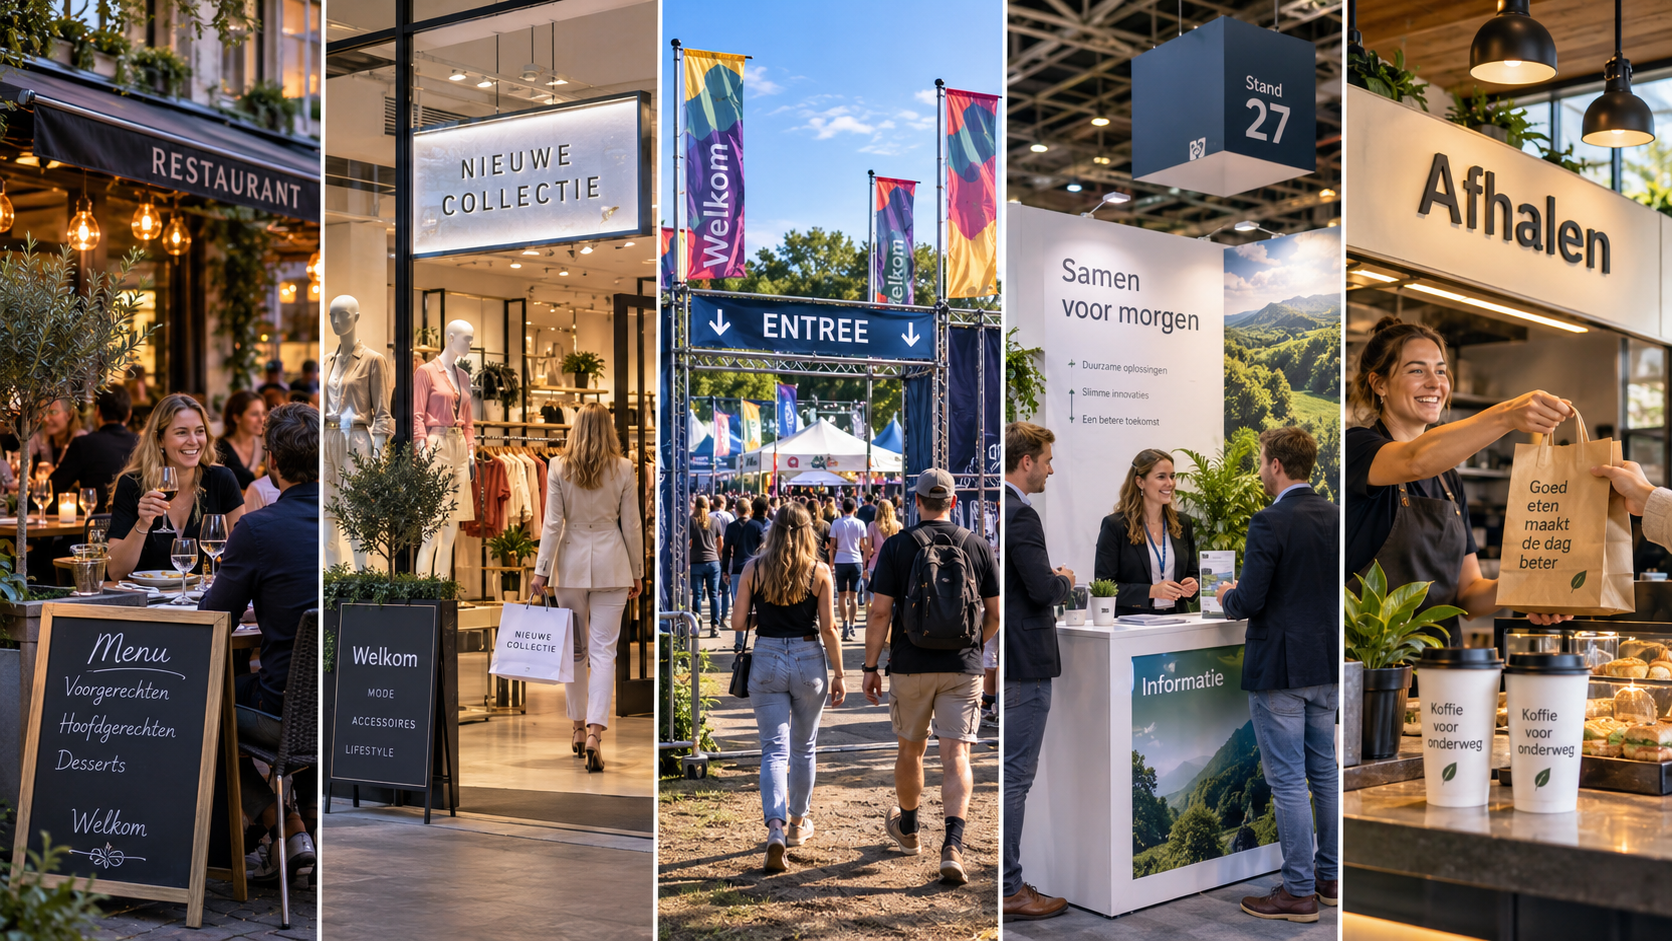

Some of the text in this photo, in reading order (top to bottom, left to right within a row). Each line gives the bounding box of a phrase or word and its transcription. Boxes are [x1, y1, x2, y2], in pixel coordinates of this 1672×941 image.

[1246, 75, 1282, 97] Stand
[1246, 98, 1290, 144] 27
[461, 144, 572, 178] NIEUWE
[152, 147, 301, 209] RESTAURANT
[442, 176, 600, 216] COLLECTIE
[704, 144, 729, 268] Welkom
[1418, 153, 1610, 274] Afhalen
[1062, 258, 1140, 291] Samen
[1062, 300, 1199, 334] voor morgen
[763, 313, 868, 343] ENTREE
[1082, 360, 1167, 376] Duurzame oplossingen
[1082, 387, 1149, 400] Slimme innovaties
[1082, 415, 1159, 426] Een betere toekomst
[1529, 480, 1567, 495] Goed
[1527, 499, 1559, 513] eten
[1525, 517, 1570, 531] maakt
[1522, 536, 1571, 552] de dag
[1519, 555, 1558, 570] beter
[515, 630, 552, 641] NIEUWE
[87, 633, 171, 664] Menu
[506, 641, 556, 653] COLLECTIE
[353, 646, 418, 667] Welkom
[1142, 669, 1223, 695] Informatie
[65, 675, 169, 706] Voorgerechten
[367, 688, 395, 699] MODE
[1431, 702, 1463, 716] Koffie
[1522, 708, 1558, 722] Koffie
[59, 712, 176, 743] Hoofdgerechten
[352, 716, 416, 729] ACCESSOIRES
[1433, 722, 1459, 733] voor
[1525, 727, 1553, 738] voor
[345, 744, 394, 757] LIFESTYLE
[1428, 736, 1483, 752] onderweg
[1518, 743, 1574, 757] onderweg
[55, 750, 126, 773] Desserts
[72, 808, 147, 837] Welkom
